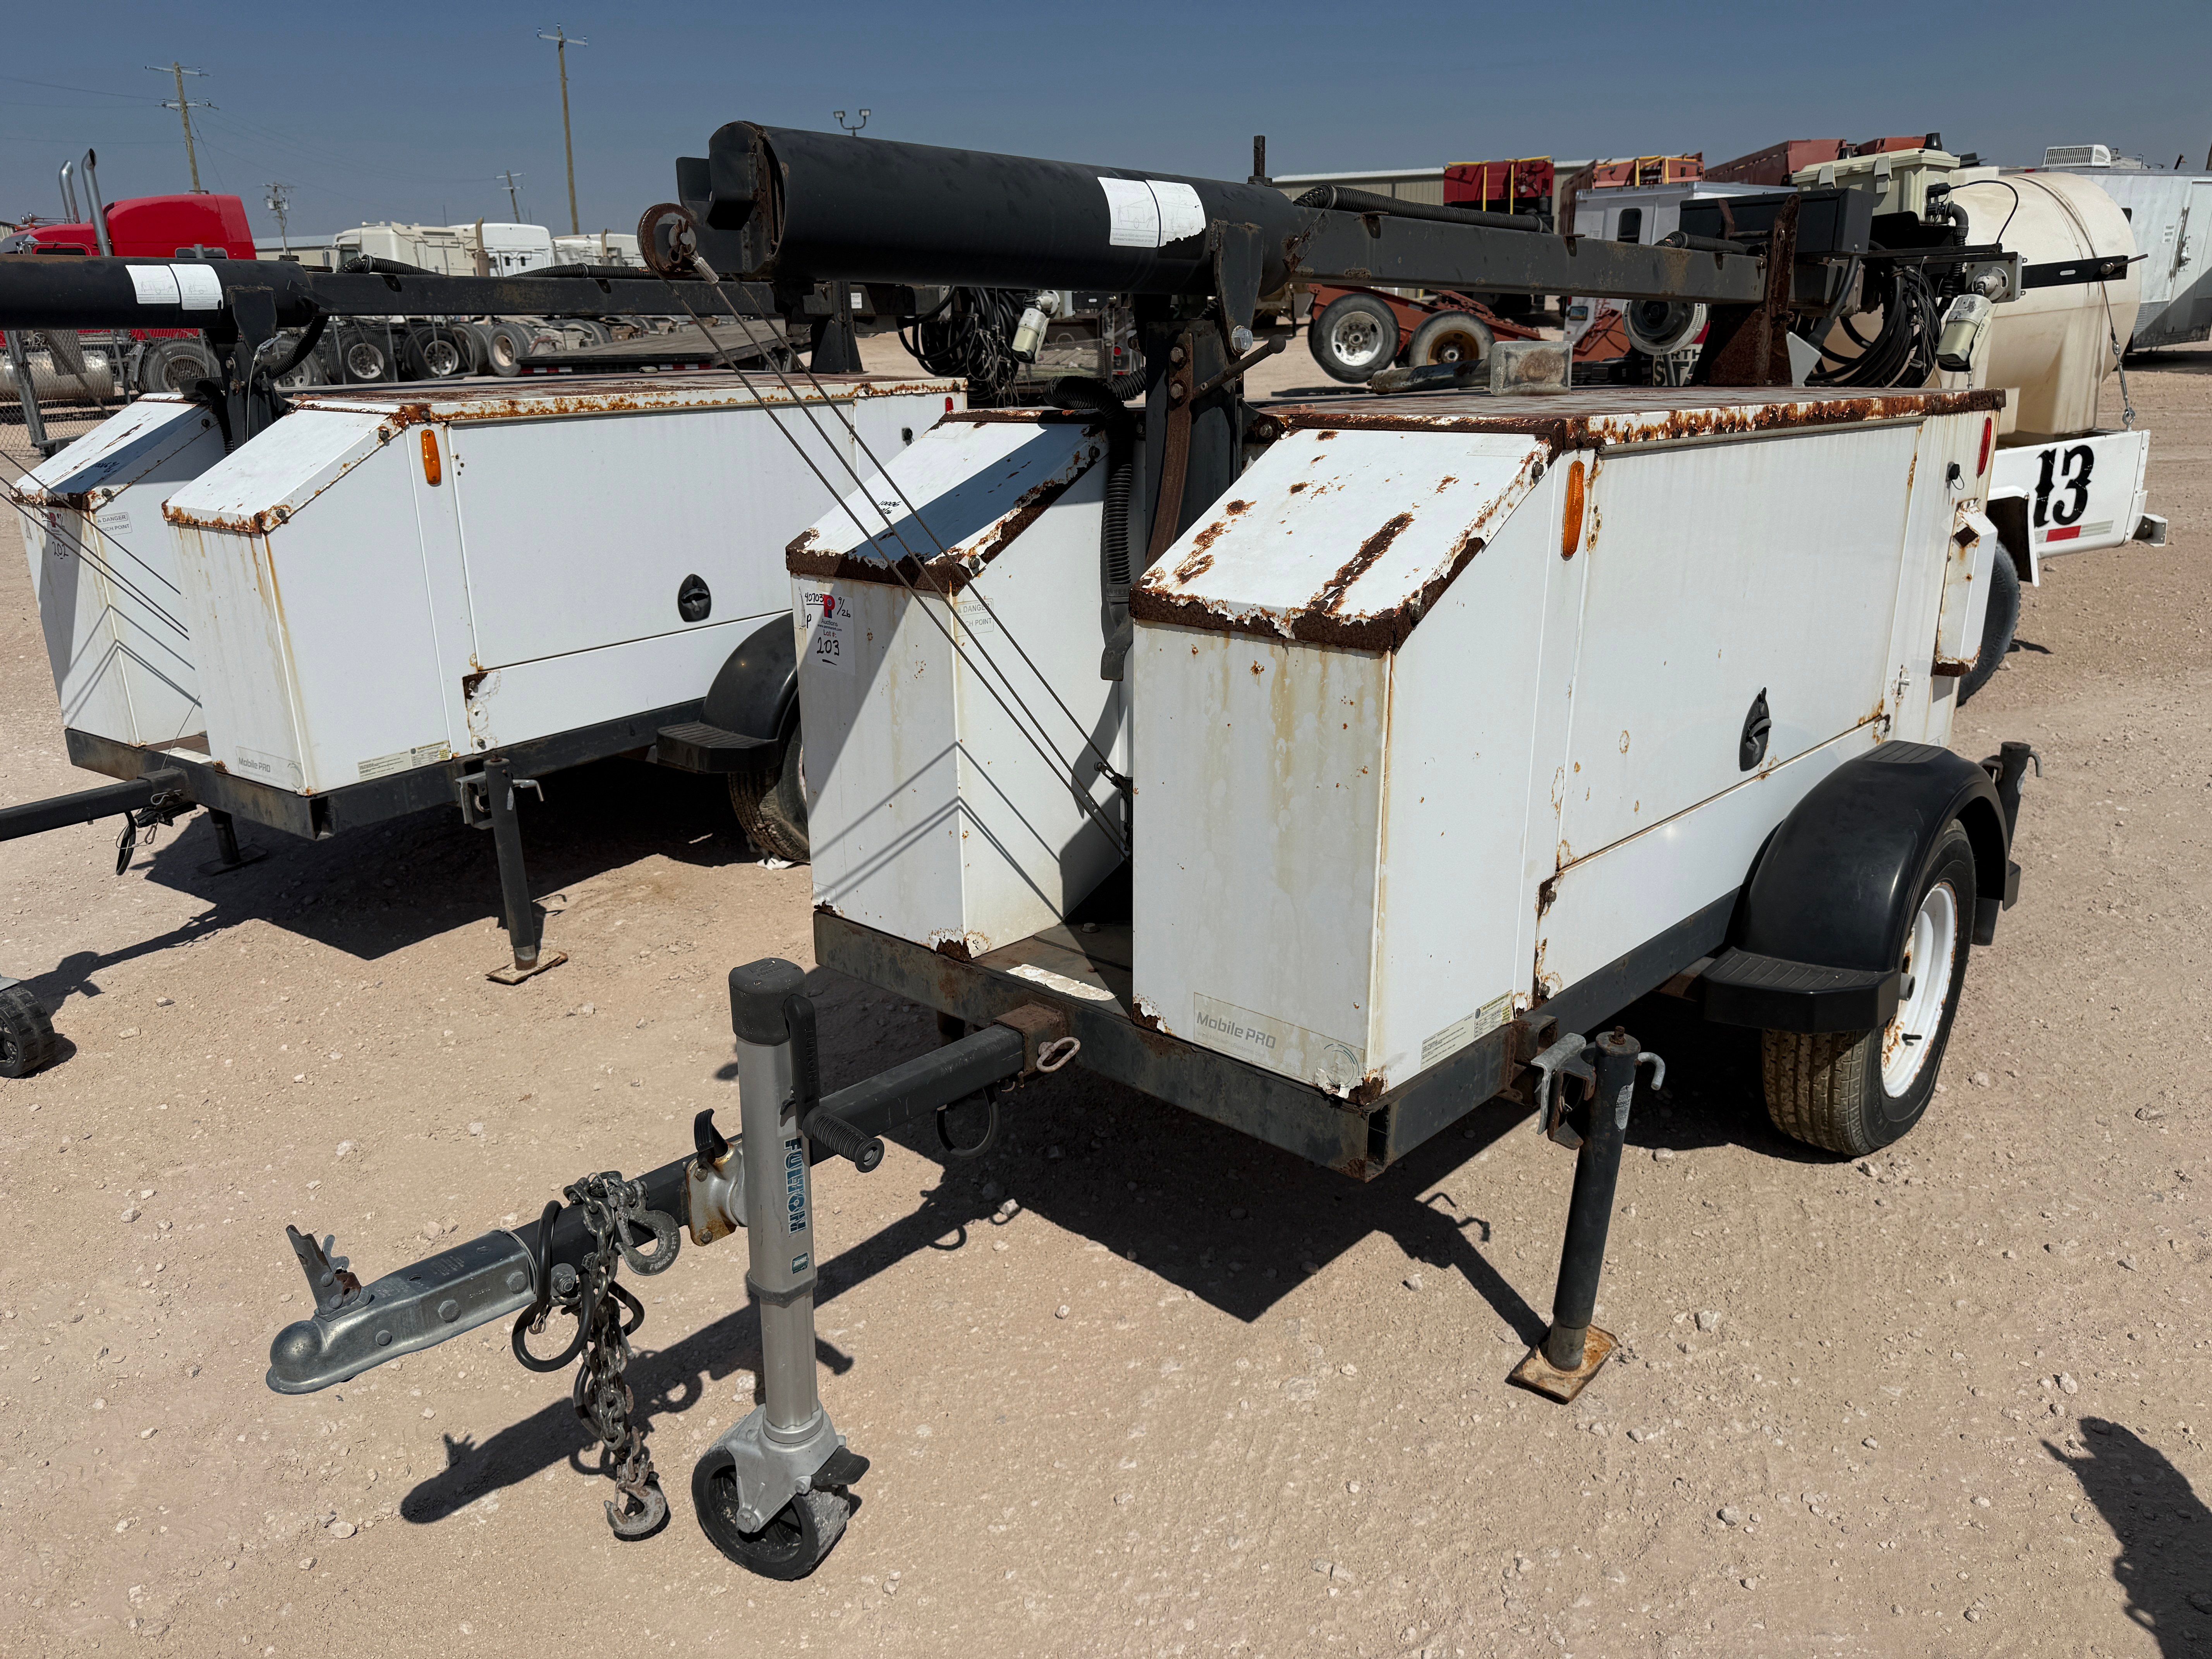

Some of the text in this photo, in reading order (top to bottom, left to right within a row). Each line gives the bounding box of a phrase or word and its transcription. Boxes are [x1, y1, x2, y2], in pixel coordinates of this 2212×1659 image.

[1656, 349, 1701, 360] RTH
[2033, 445, 2095, 528] 13
[52, 541, 69, 557] 202
[805, 592, 824, 603] 40703
[821, 618, 838, 627] Auctions
[975, 618, 992, 626] POINT
[816, 636, 840, 656] 203
[239, 757, 271, 773] Mobile PRO
[1197, 1012, 1276, 1049] Mobile PRO
[783, 1136, 808, 1235] FULTON
